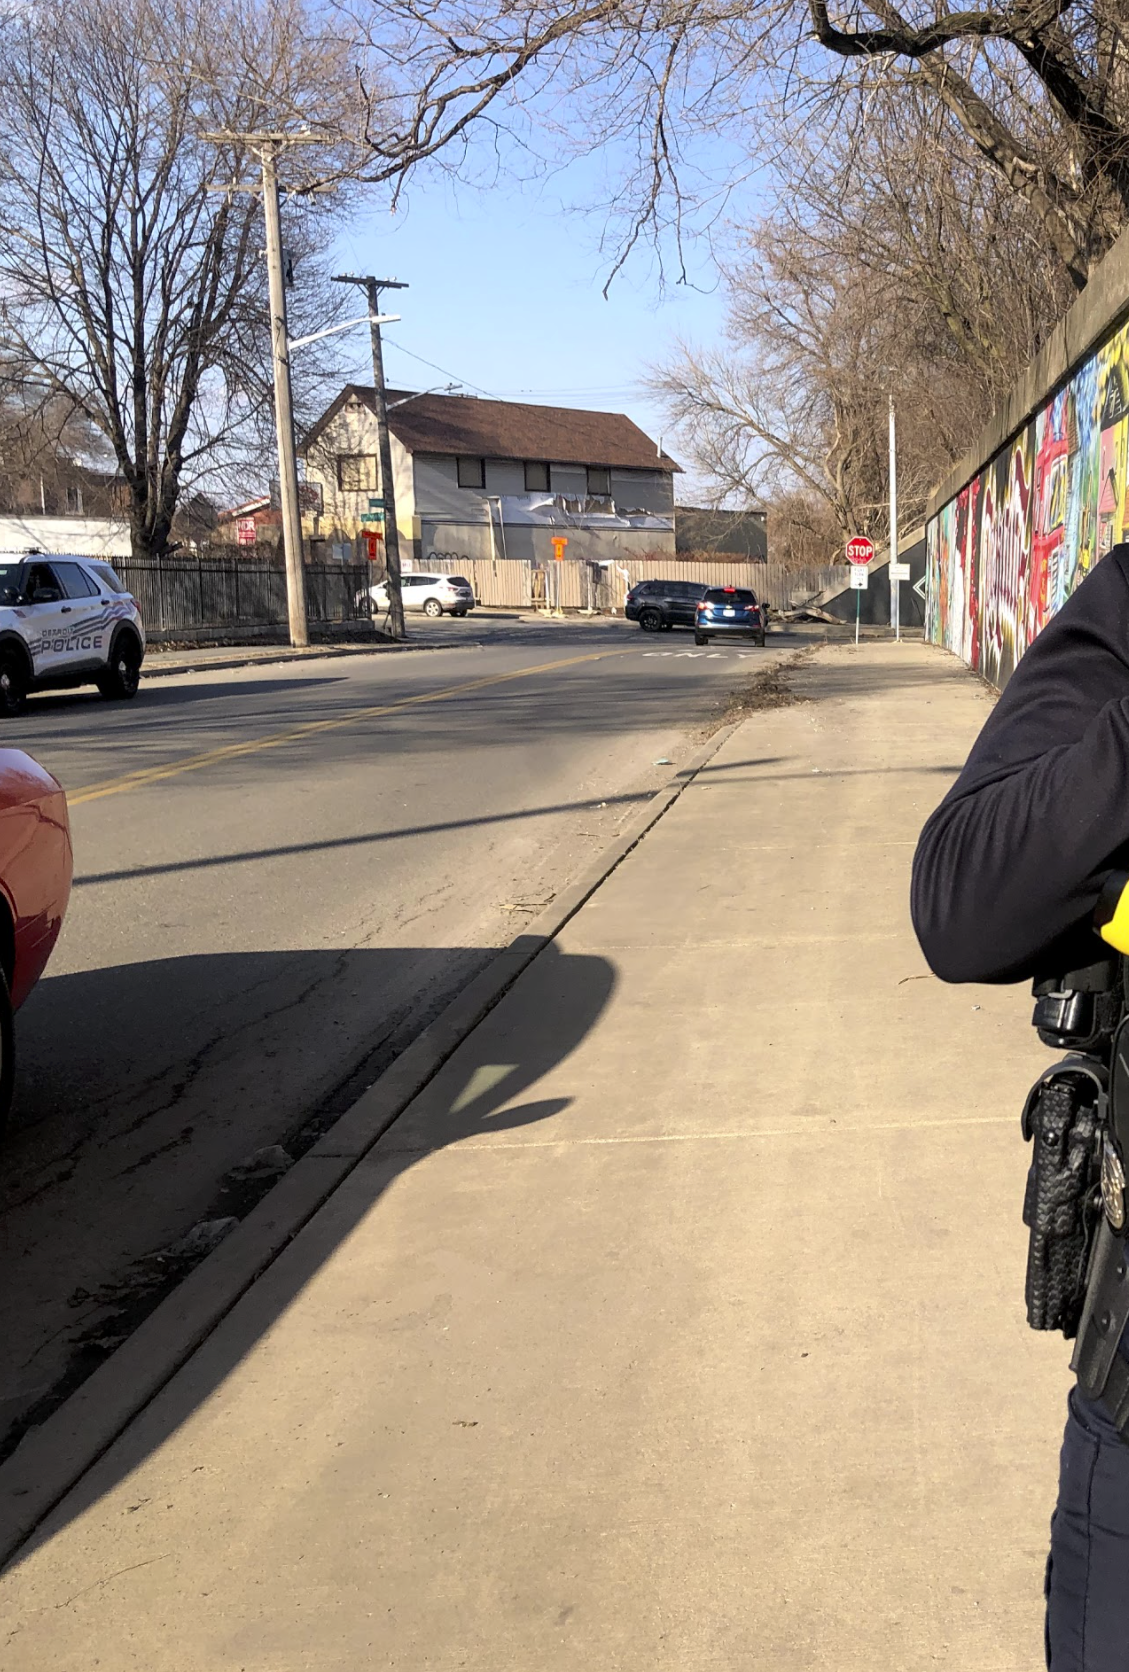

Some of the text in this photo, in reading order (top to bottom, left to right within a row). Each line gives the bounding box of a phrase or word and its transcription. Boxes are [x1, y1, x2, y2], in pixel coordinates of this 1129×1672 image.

[848, 545, 873, 557] STOP
[41, 635, 104, 653] POLICE
[642, 651, 764, 659] ONLY
